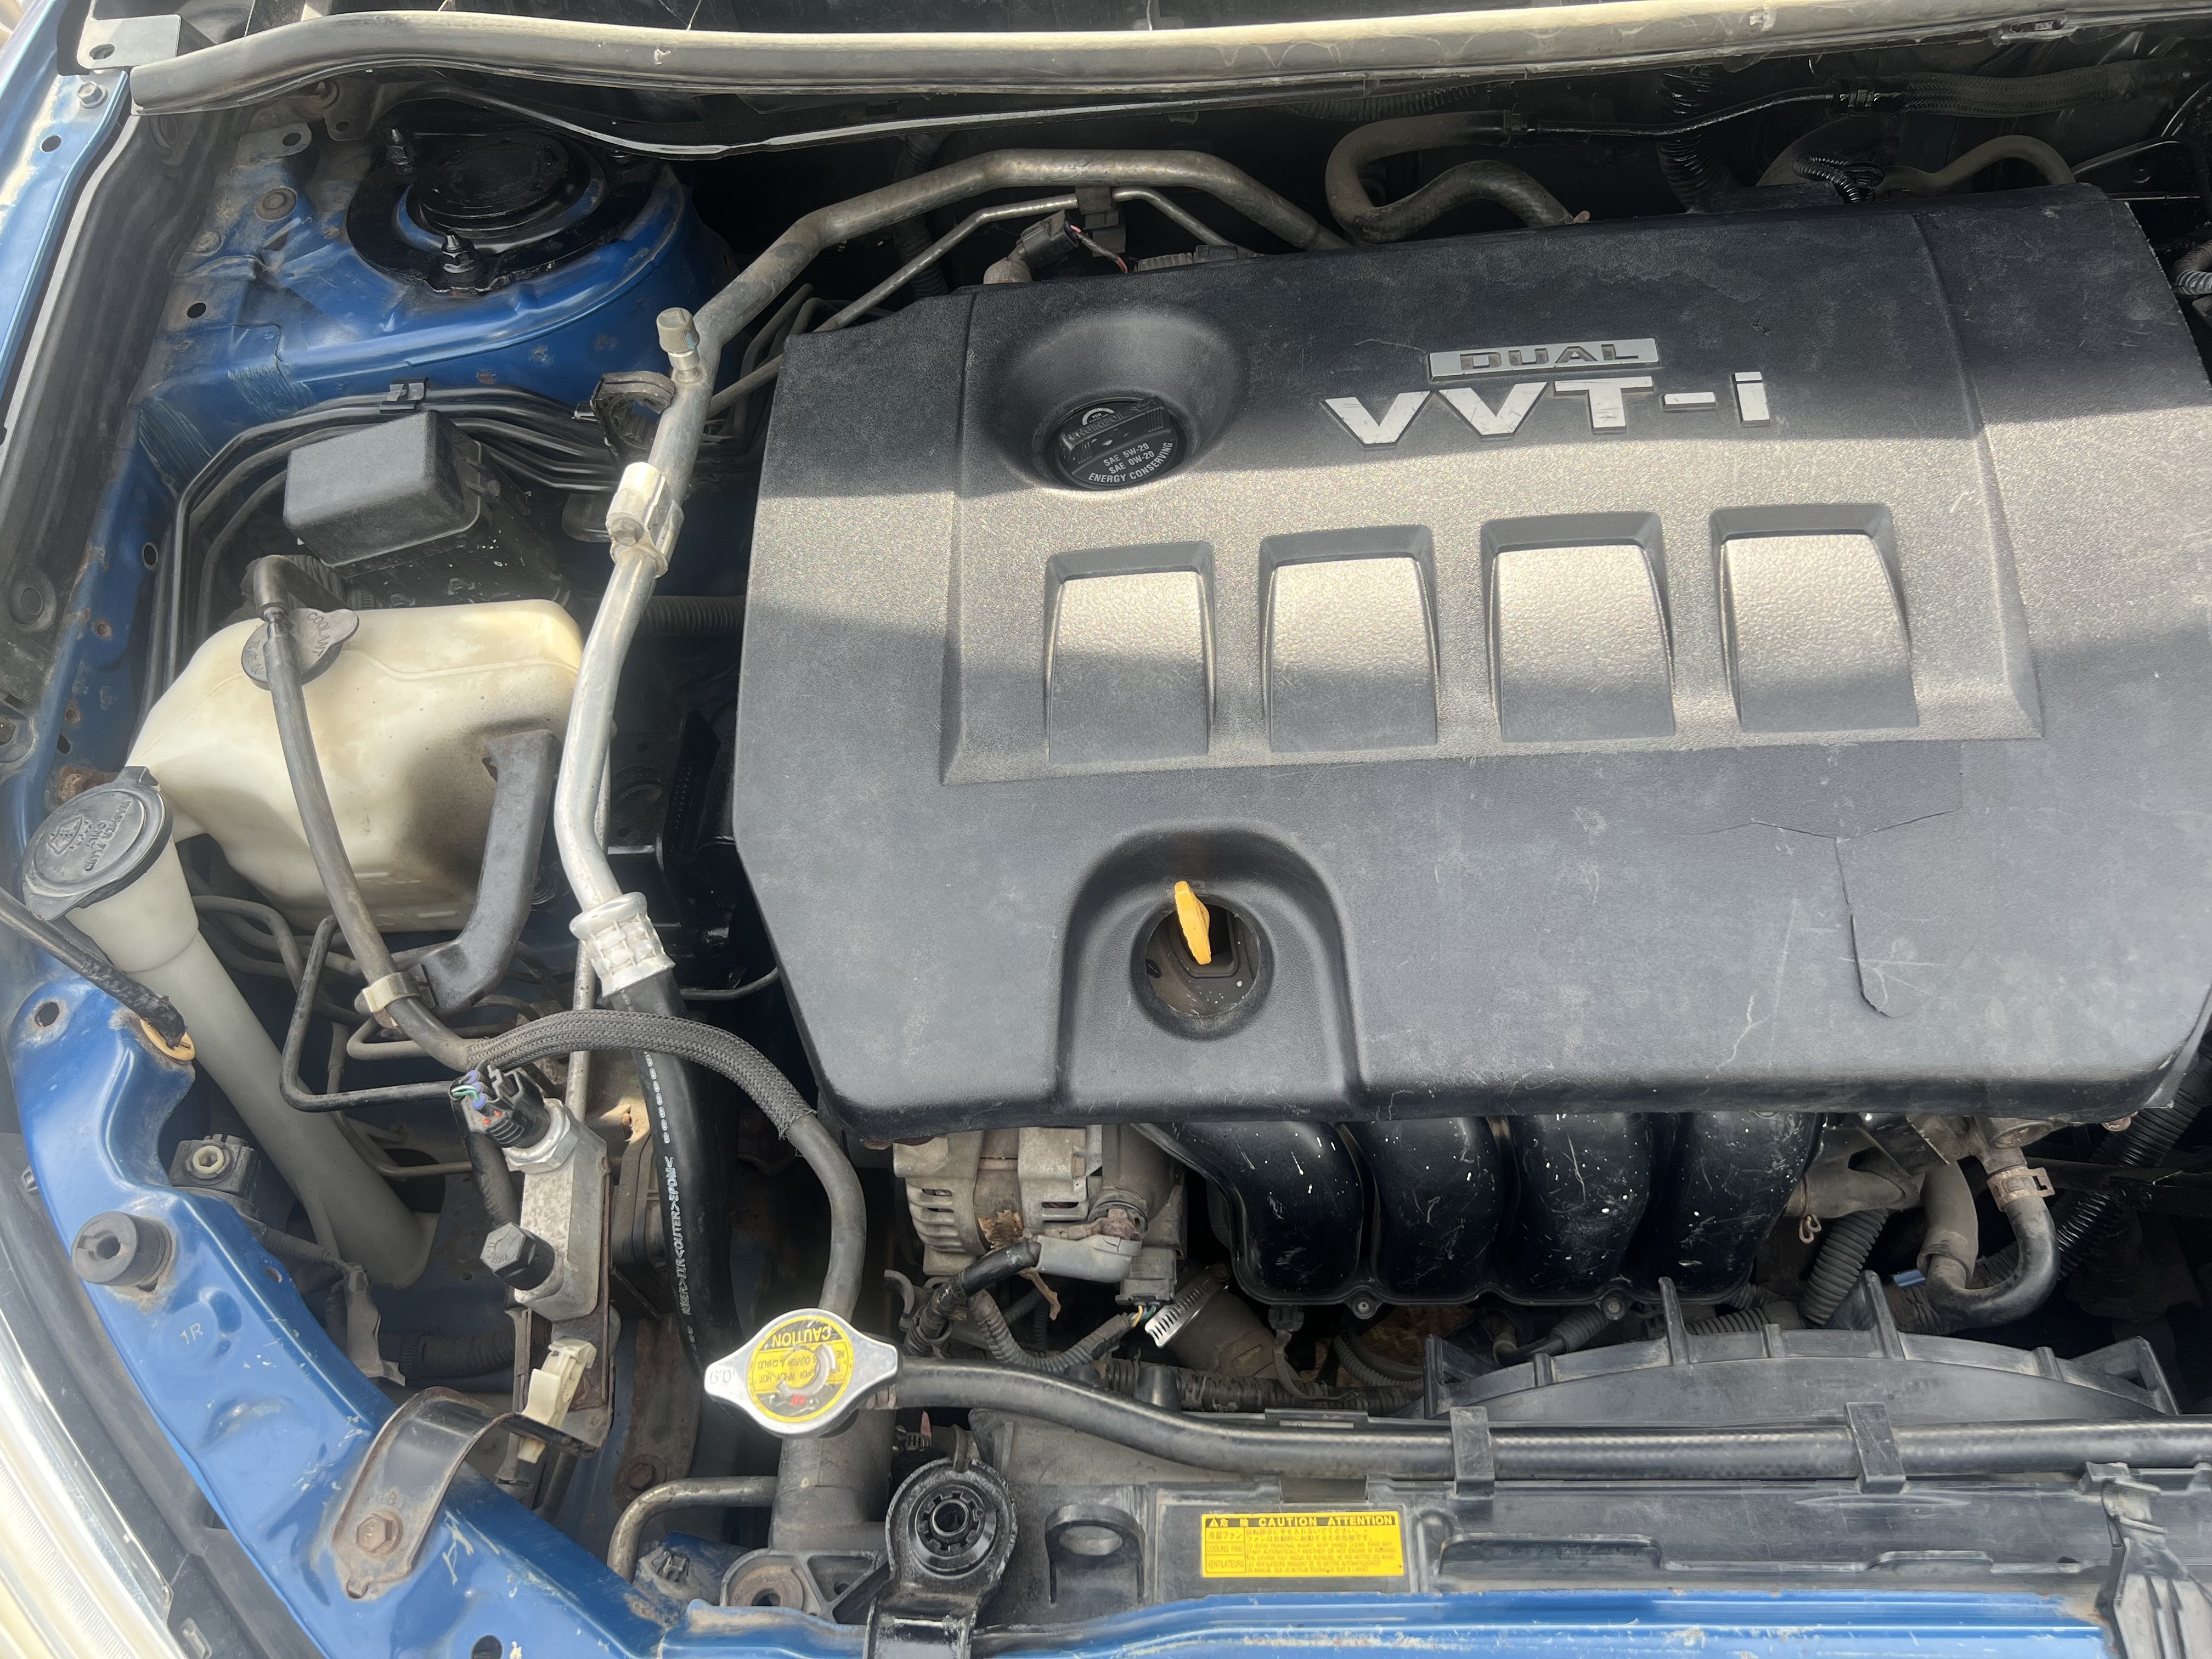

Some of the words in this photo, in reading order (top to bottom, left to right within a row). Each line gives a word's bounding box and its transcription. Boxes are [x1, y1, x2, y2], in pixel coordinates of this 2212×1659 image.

[1459, 344, 1639, 370] DUAL
[1322, 371, 1770, 448] VVT-i
[1088, 472, 1126, 483] ENERGY
[1129, 442, 1173, 479] CONSERVING
[1103, 454, 1121, 466] SAE
[1122, 443, 1149, 458] 5W-20
[1109, 462, 1126, 474] SAE
[1128, 450, 1155, 465] 0W-20
[307, 612, 330, 657] COOLANT
[86, 822, 106, 848] ONLY
[84, 843, 106, 871] FLUID
[772, 1325, 833, 1347] CAUTION
[788, 1356, 811, 1367] OUVRIR
[777, 1373, 795, 1382] WHEN
[1259, 1517, 1317, 1527] CAUTION
[1328, 1515, 1393, 1526] ATTENTION
[1207, 1544, 1229, 1553] COOLING
[1231, 1544, 1244, 1553] FANS
[1208, 1559, 1244, 1568] VENTILATEURS
